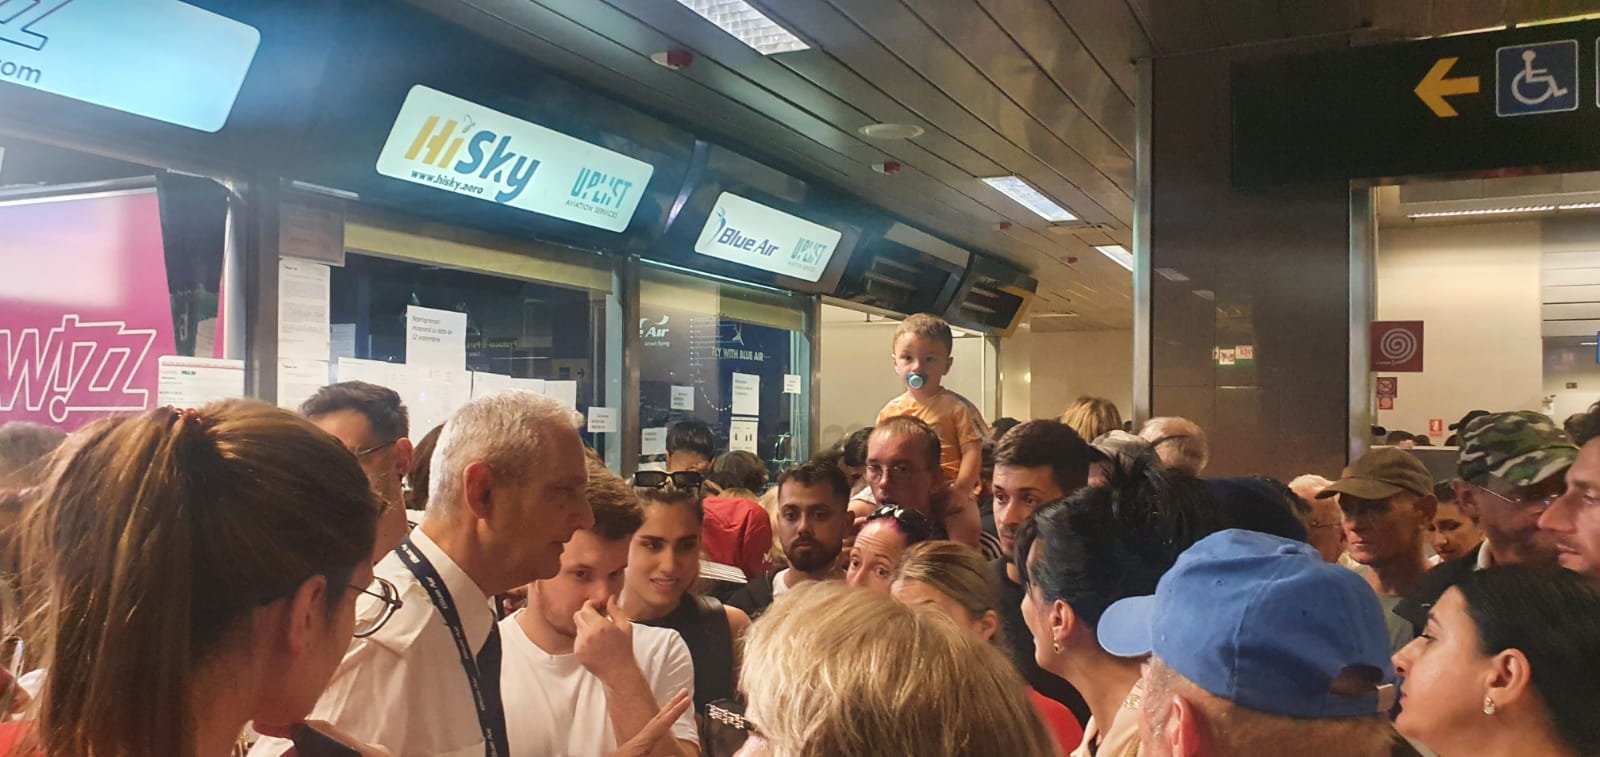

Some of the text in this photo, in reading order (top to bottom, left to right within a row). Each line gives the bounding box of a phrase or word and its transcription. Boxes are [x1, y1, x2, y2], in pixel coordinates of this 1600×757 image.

[0, 57, 42, 83] om
[404, 115, 540, 203] HiSky
[410, 169, 484, 194] www.hisky.aero
[570, 167, 632, 209] UPLIFT
[718, 227, 779, 257] Blue Air
[644, 326, 670, 338] Air
